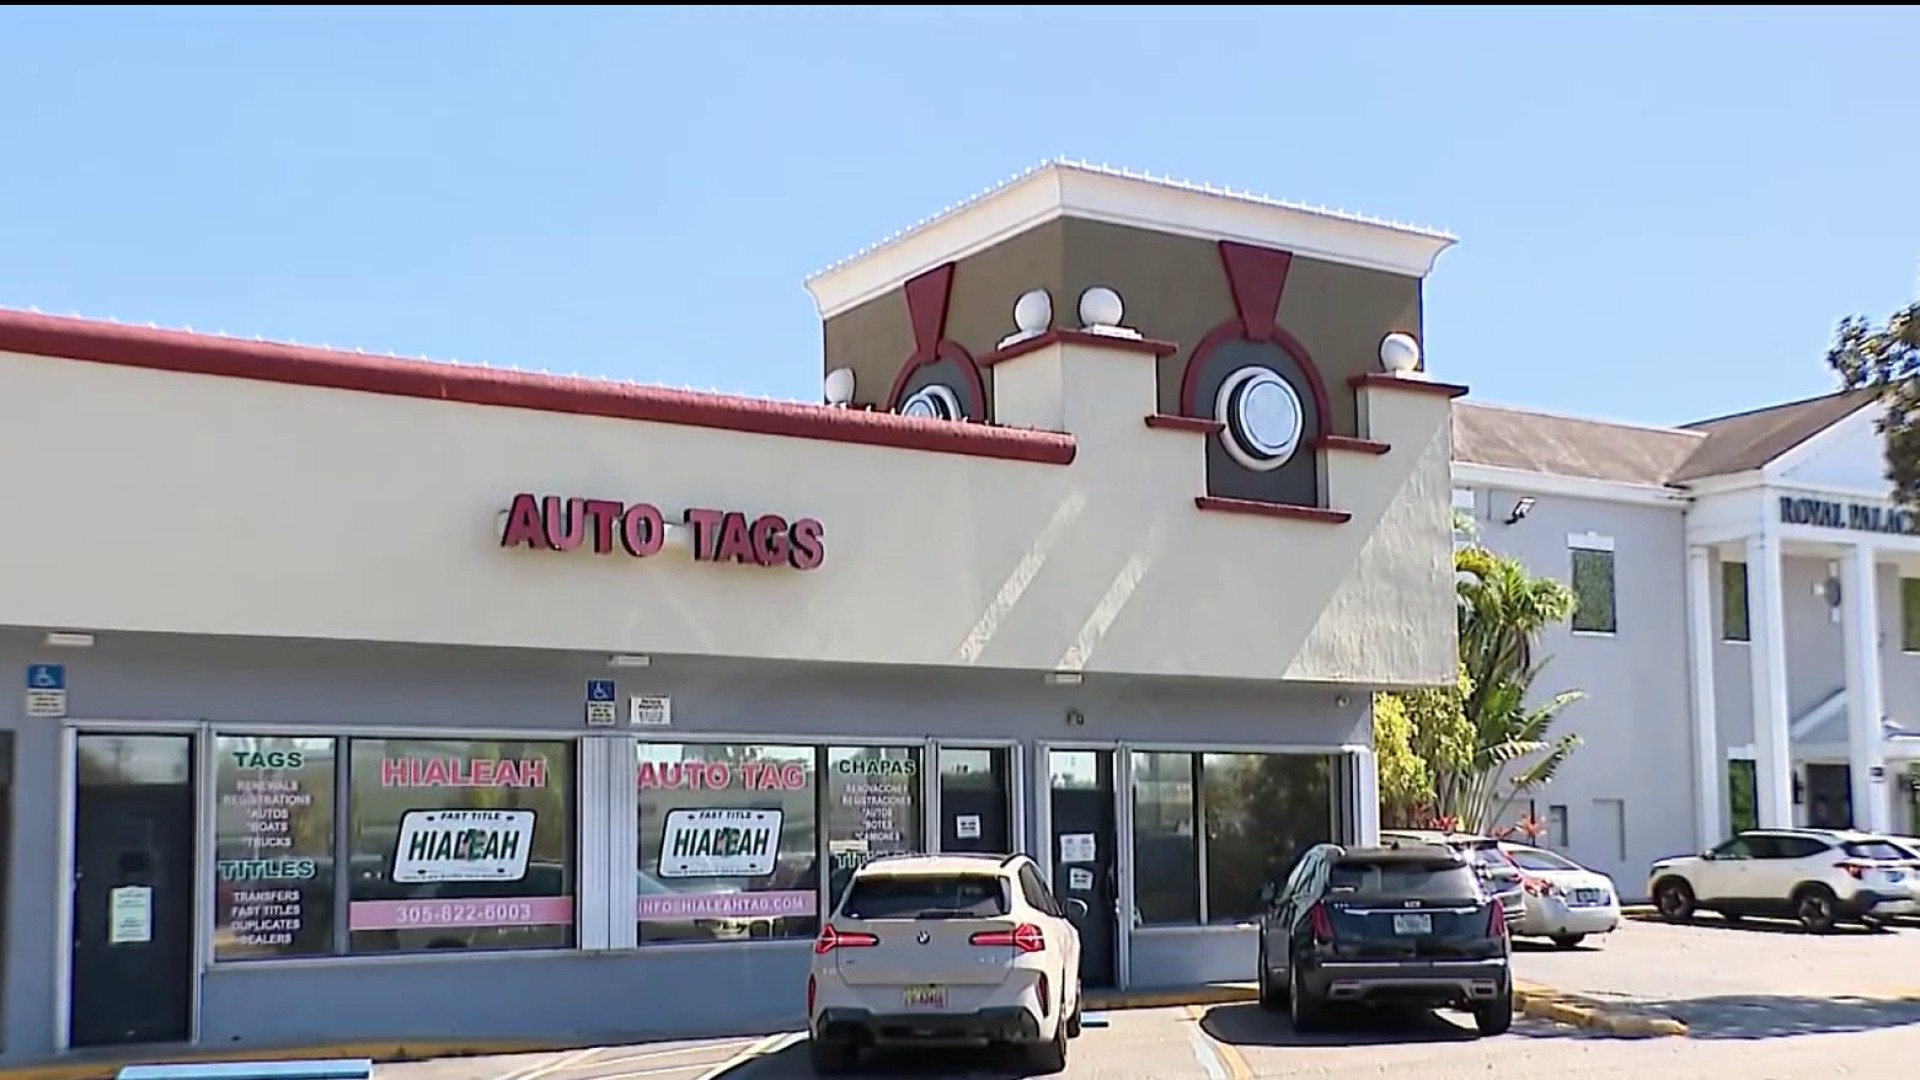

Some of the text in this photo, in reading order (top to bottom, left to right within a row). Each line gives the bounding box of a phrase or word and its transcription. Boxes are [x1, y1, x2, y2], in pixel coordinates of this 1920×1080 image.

[1779, 496, 1845, 528] ROYAL
[501, 492, 825, 571] AUTO TAGS
[231, 751, 304, 770] TAGS
[838, 757, 917, 776] CHAPAS
[381, 755, 547, 788] HIALEAH
[637, 762, 807, 791] AUTO TAG
[440, 812, 502, 822] FAST TITLE
[699, 812, 752, 820] FAST TITLE
[407, 828, 521, 863] HIALEAH
[673, 826, 770, 857] HIALEAH
[218, 859, 315, 880] TITLES
[233, 890, 300, 905] TRANSFERS
[231, 904, 301, 918] FAST TITLES
[395, 903, 532, 923] 305-822-6003
[230, 919, 301, 933] DUPLICATES
